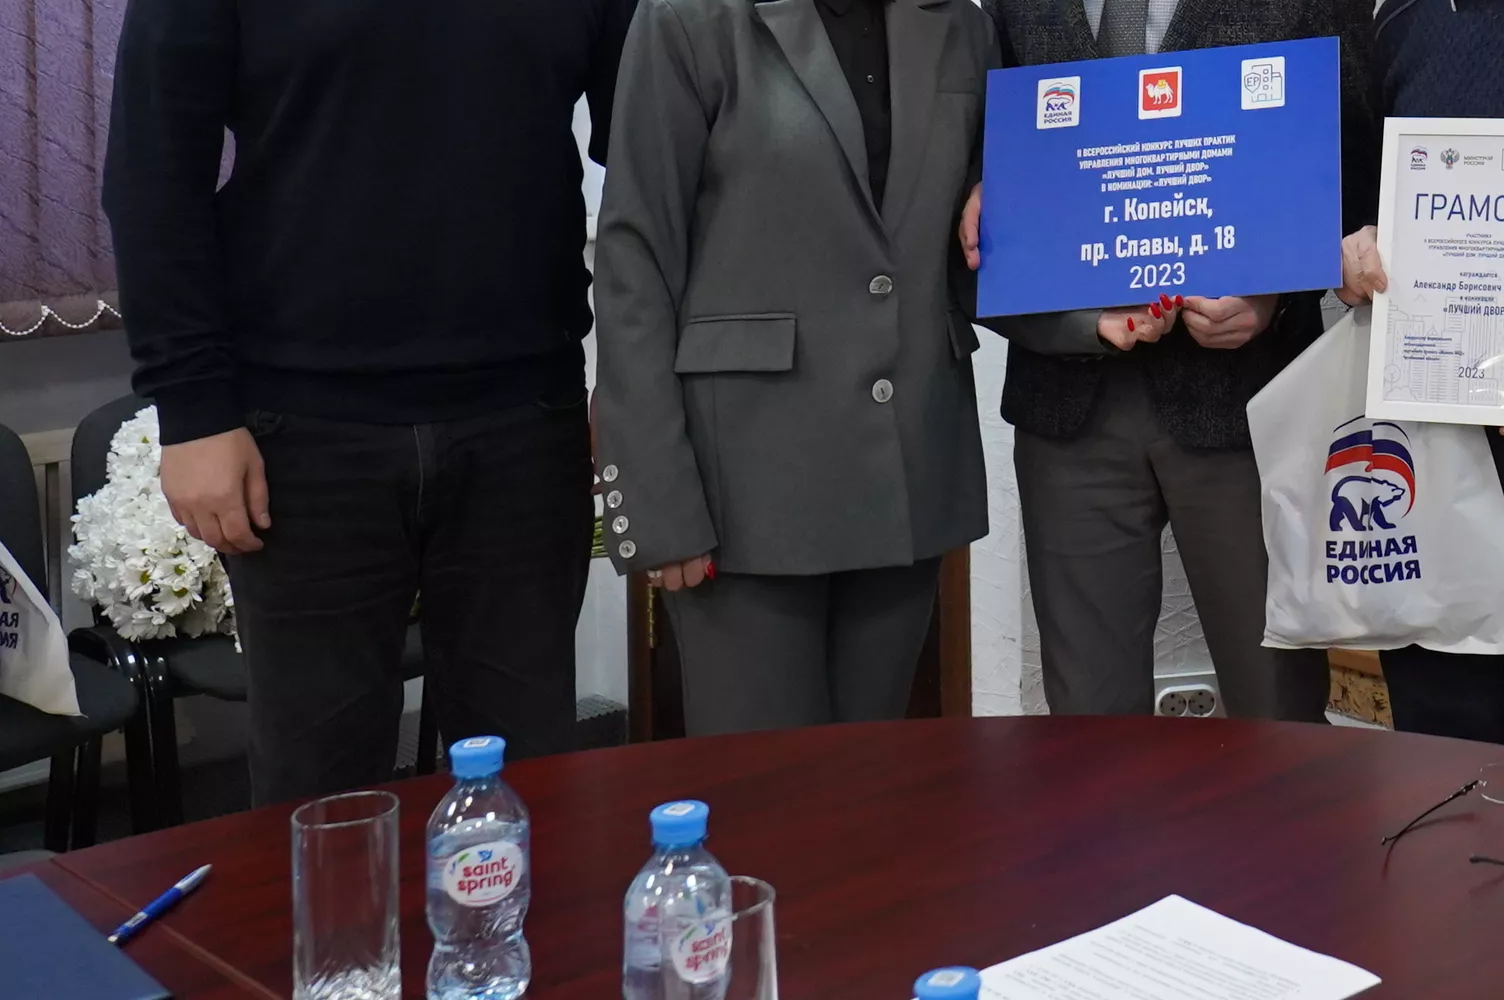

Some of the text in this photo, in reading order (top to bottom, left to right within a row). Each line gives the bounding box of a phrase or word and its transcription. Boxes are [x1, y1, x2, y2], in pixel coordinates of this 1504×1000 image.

[1044, 111, 1072, 119] ЕДИНАЯ
[1083, 142, 1140, 158] ВСЕРОССИЙСКИЙ
[1142, 140, 1173, 152] КОНКУРС
[1174, 138, 1202, 149] ЛУЧШИХ
[1204, 134, 1236, 146] ПРАКТИК
[1079, 147, 1233, 170] УПРАВЛЕНИЯ МНОГОКВАРТИРНЫМИ ДОМАМИ
[1102, 167, 1134, 180] «ЛУЧШИЙ
[1156, 163, 1184, 175] ЛУЧШИЙ
[1185, 162, 1209, 174] ДВОР»
[1102, 183, 1106, 192] В
[1154, 174, 1186, 187] «ЛУЧШИЙ
[1188, 174, 1212, 186] ДВОР»
[1104, 193, 1213, 224] г. Копейск,
[1080, 225, 1235, 267] пр. Славы, д. 18
[1129, 262, 1186, 288] 2023
[1413, 280, 1456, 292] Александр
[1458, 281, 1502, 293] Борисович
[1442, 303, 1482, 315] «ЛУЧШИЙ
[1458, 366, 1485, 380] 2023
[1326, 535, 1418, 561] ЕДИНАЯ
[1326, 560, 1421, 584] РОССИЯ
[462, 856, 508, 878] saint
[457, 870, 514, 896] spring
